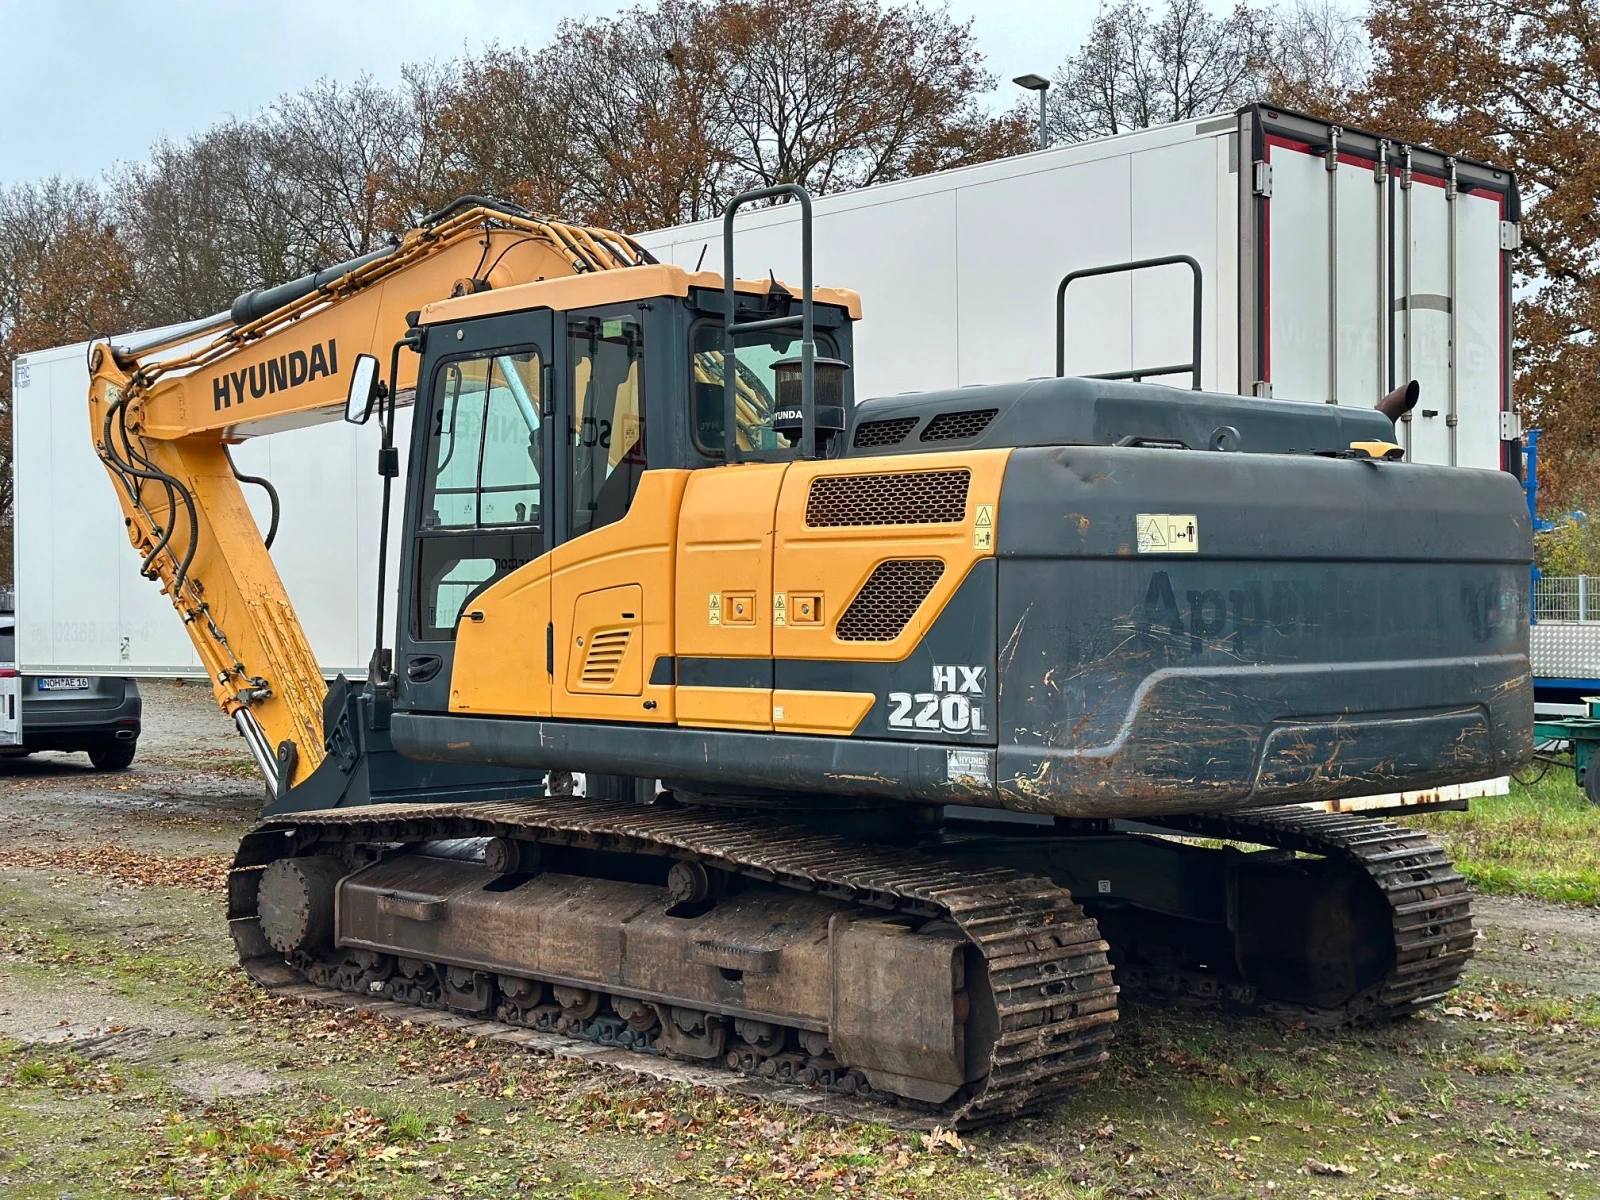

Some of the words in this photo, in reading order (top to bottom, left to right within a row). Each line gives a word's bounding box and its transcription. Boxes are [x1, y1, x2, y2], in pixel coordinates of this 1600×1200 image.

[213, 338, 338, 411] HYUNDAI
[774, 410, 803, 421] YUNDA
[44, 679, 61, 688] NOH
[65, 678, 75, 687] AE
[77, 678, 87, 687] 16
[932, 665, 984, 694] HX
